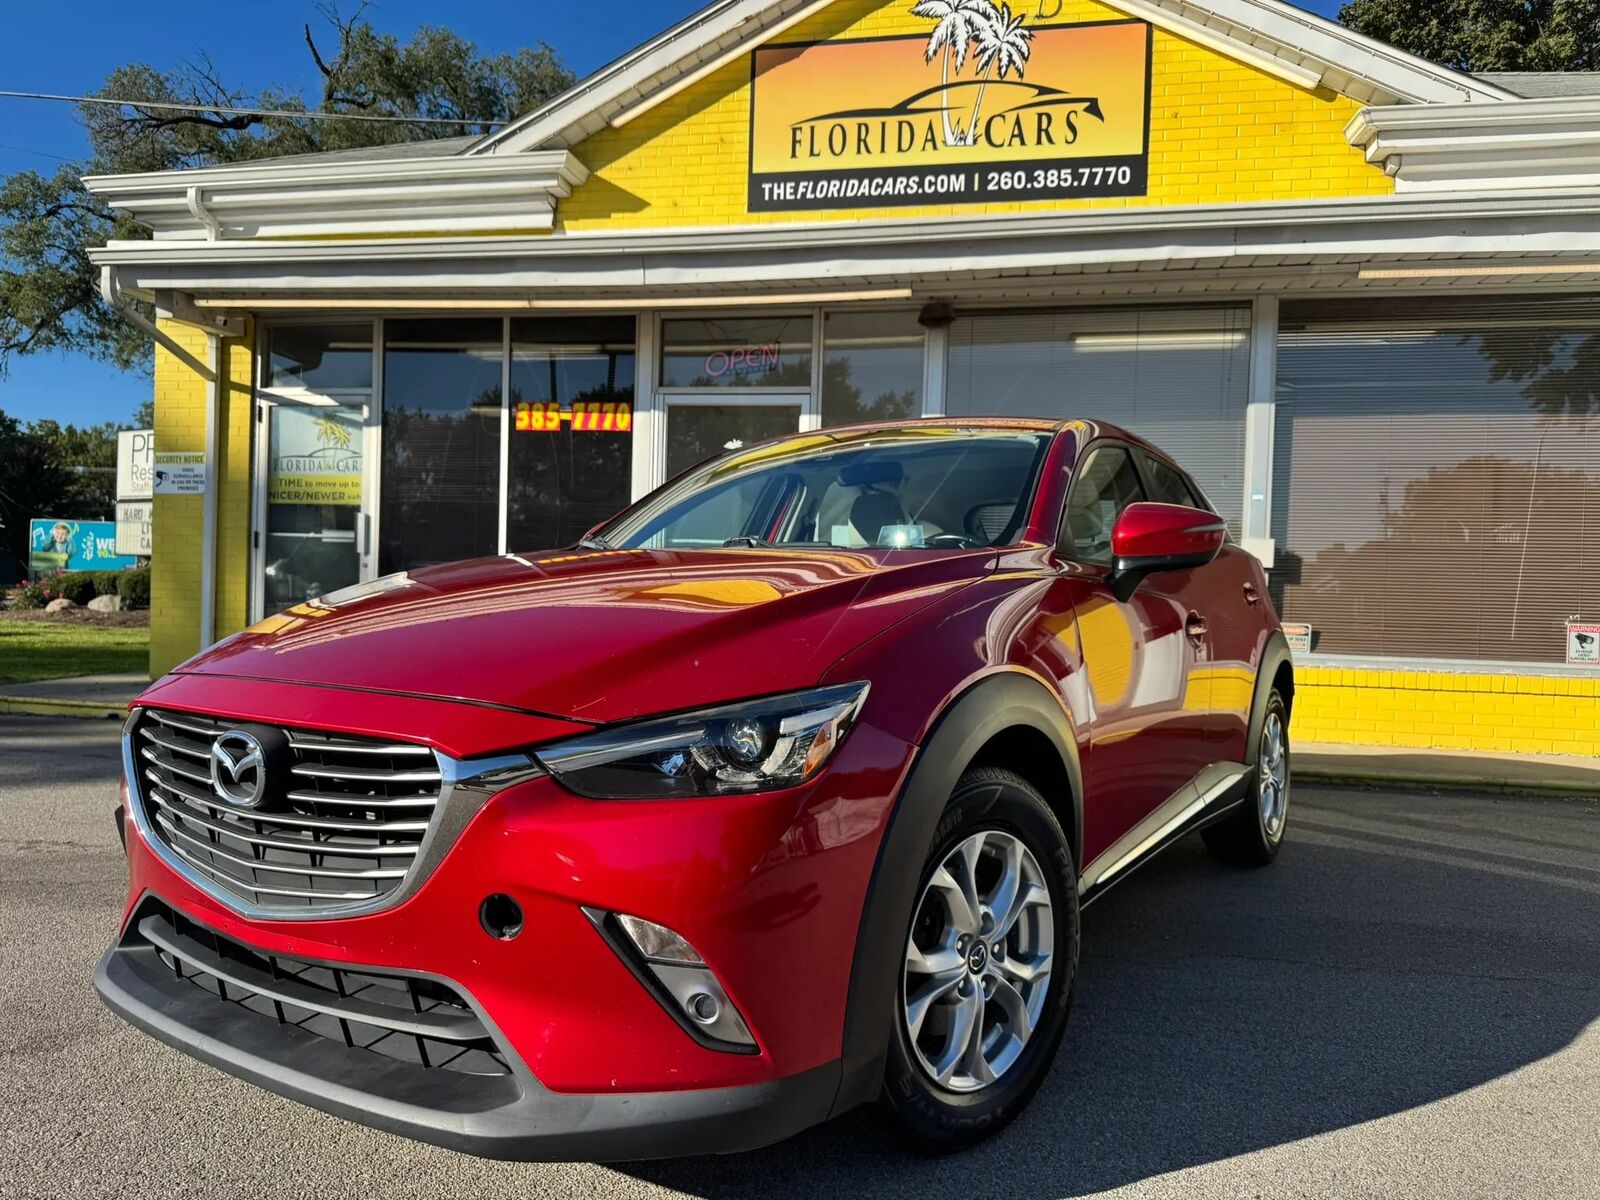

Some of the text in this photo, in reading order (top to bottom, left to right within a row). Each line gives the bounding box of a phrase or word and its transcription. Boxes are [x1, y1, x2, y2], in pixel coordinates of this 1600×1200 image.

[790, 110, 1079, 159] FLORIDA CARS
[762, 165, 1131, 201] THEFLORIDACARS.COM 260.385.7770
[705, 343, 780, 377] OPEN
[516, 402, 631, 431] 385-7770
[154, 455, 205, 464] SECURITY NOTICE
[273, 459, 323, 472] FLORIDA
[278, 478, 303, 487] TIME
[270, 491, 345, 501] NICER/NEWER
